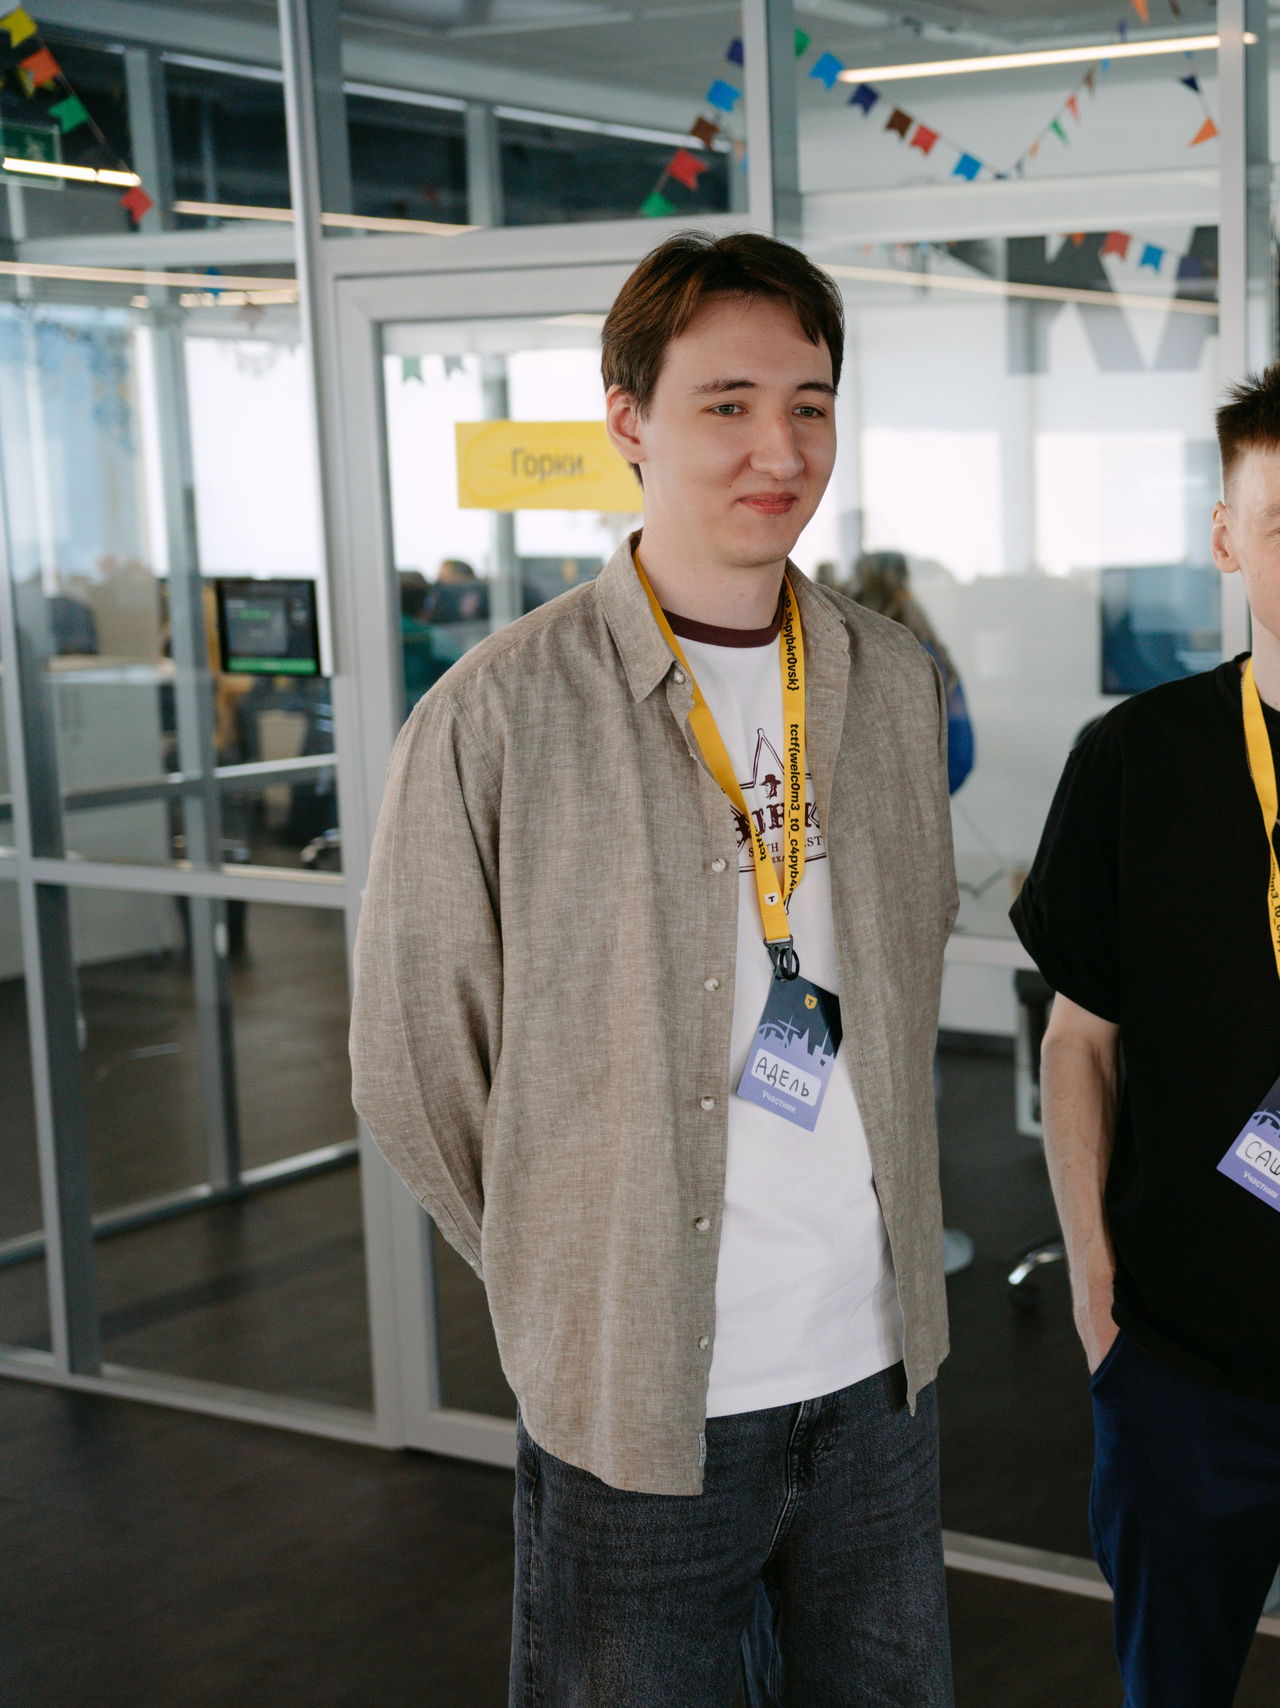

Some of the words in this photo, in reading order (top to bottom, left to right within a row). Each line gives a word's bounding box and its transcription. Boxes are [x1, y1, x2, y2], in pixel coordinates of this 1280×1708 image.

[511, 446, 584, 483] Горки
[755, 1056, 810, 1097] АДЕЛЬ
[762, 1089, 797, 1114] Участник
[1242, 1170, 1279, 1200] Участник
